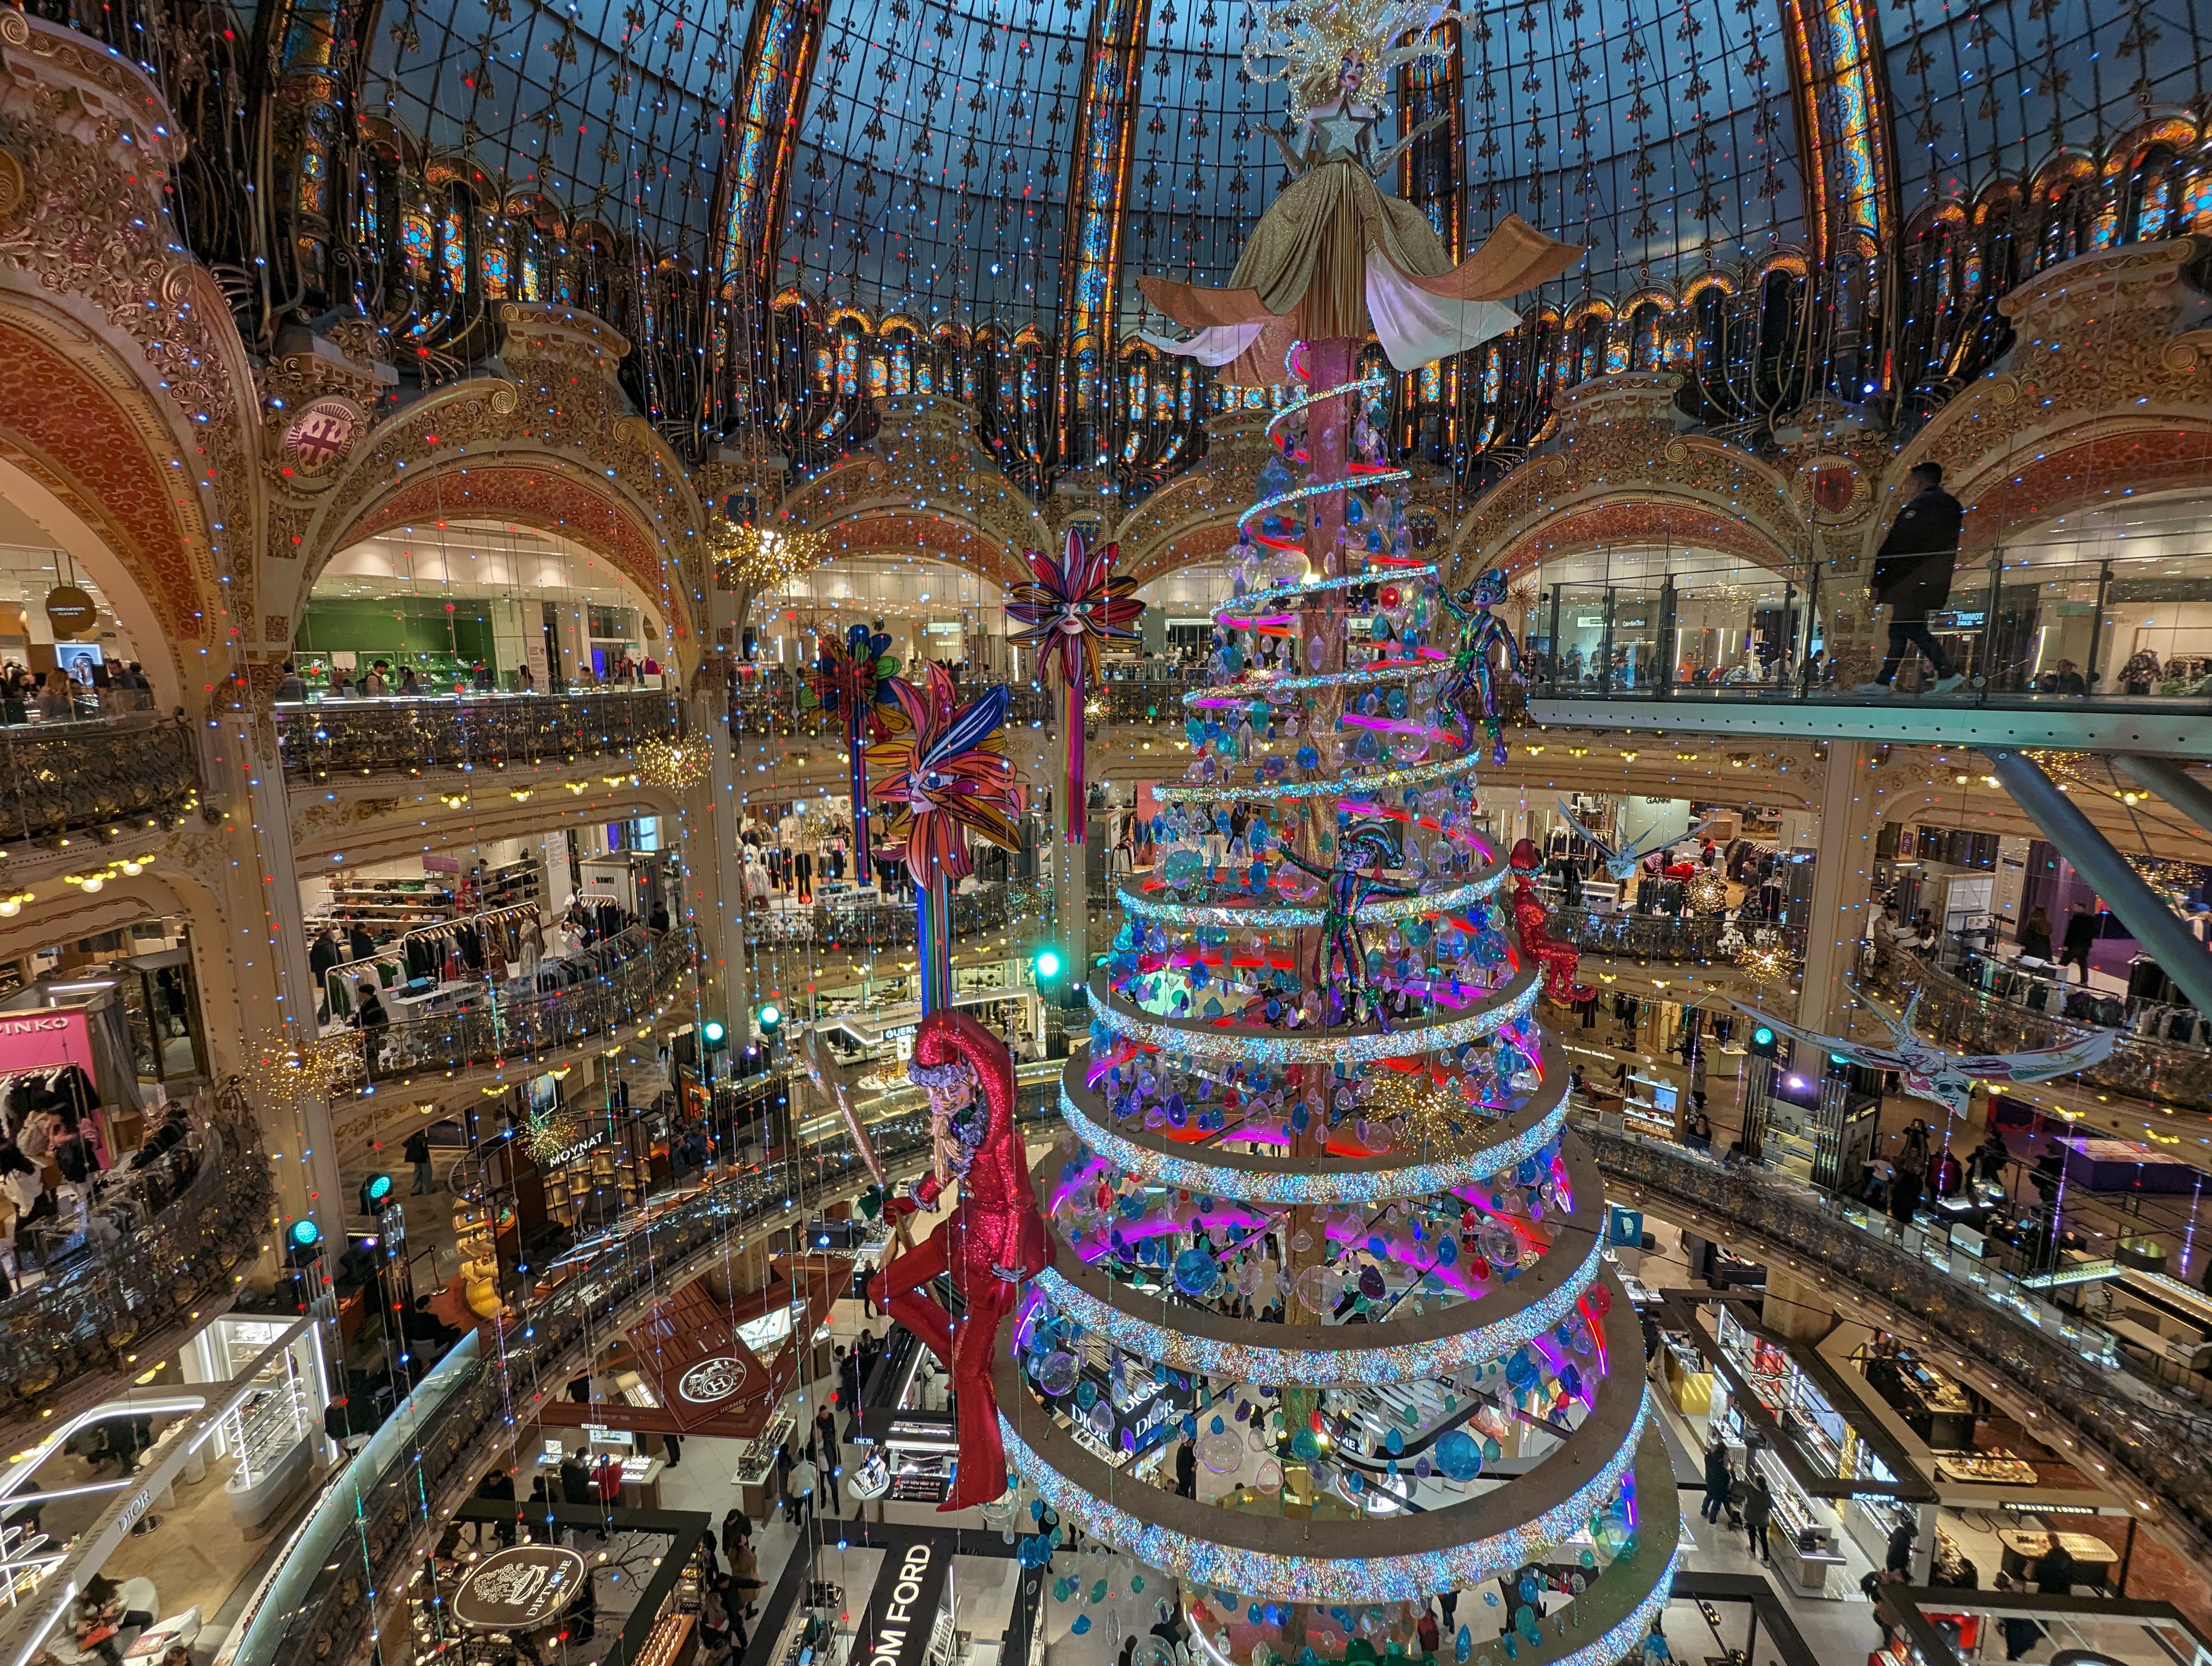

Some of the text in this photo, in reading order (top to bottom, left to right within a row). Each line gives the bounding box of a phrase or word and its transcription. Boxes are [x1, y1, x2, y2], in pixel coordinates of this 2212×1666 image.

[885, 1025, 917, 1039] GUERL
[1861, 1106, 1876, 1117] CHANEL
[550, 1131, 603, 1168] MOYNAT
[571, 1151, 585, 1161] PARIS
[708, 1377, 728, 1392] H
[853, 1437, 874, 1445] DIOR
[118, 1488, 152, 1533] DIOR
[2018, 1504, 2055, 1512] MALONE
[2056, 1506, 2094, 1515] LONDON
[525, 1560, 573, 1617] DIPTYQUE
[869, 1545, 931, 1666] OM FORD
